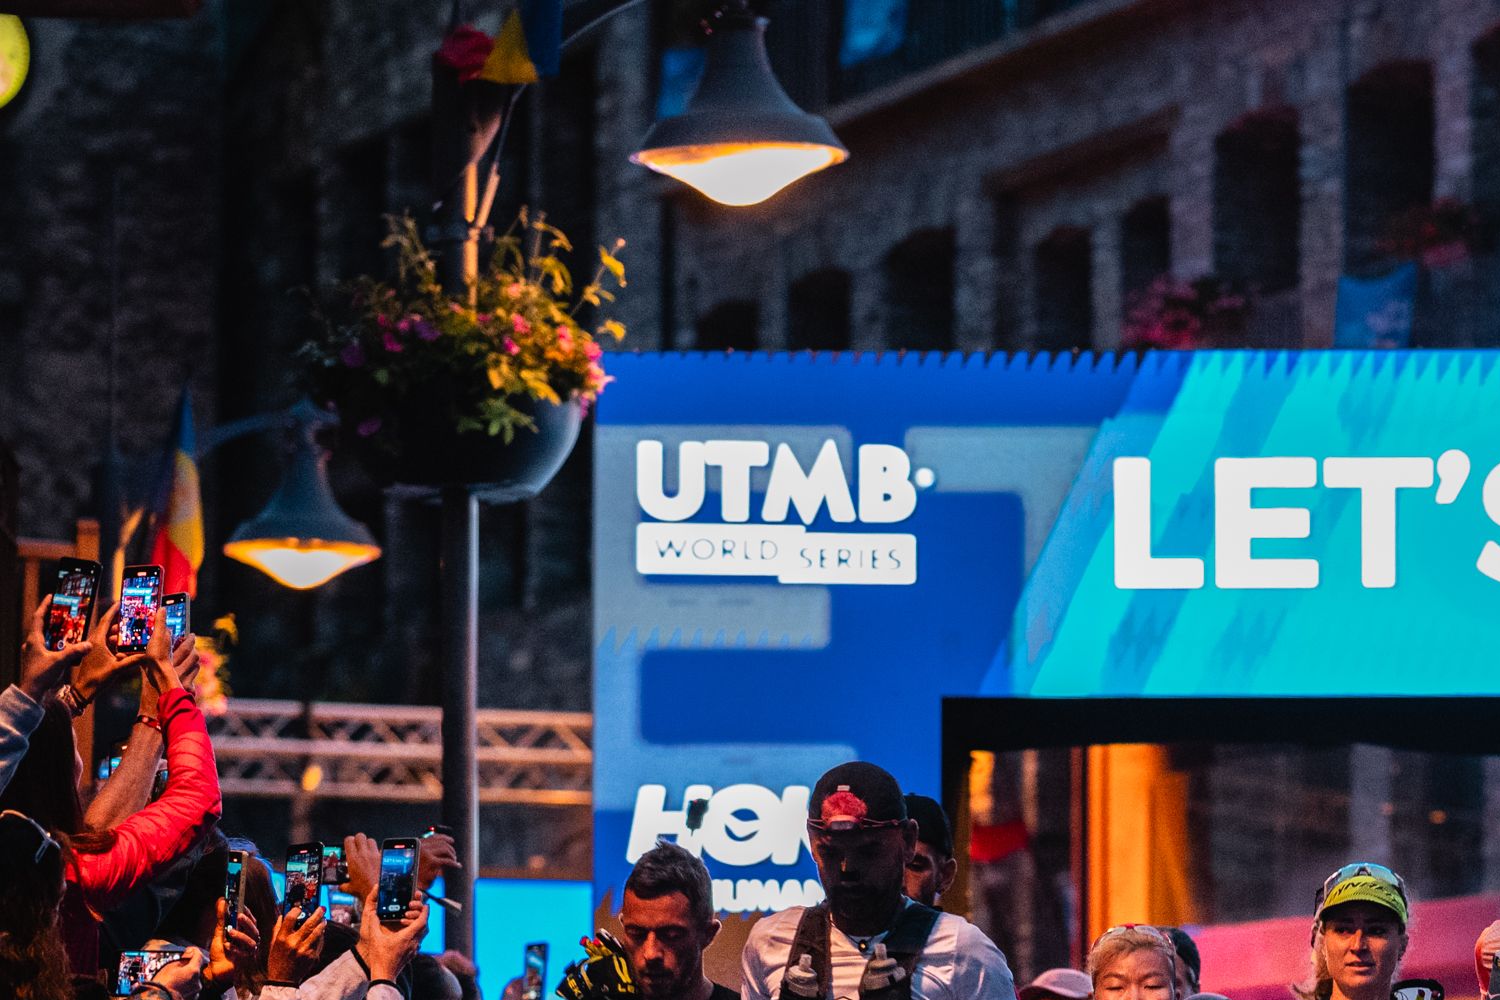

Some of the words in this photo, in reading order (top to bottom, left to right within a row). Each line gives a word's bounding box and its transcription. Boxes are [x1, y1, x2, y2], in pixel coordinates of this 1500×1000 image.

[636, 438, 917, 524] UTMB
[655, 538, 779, 561] WORLD
[799, 547, 902, 571] SERIES
